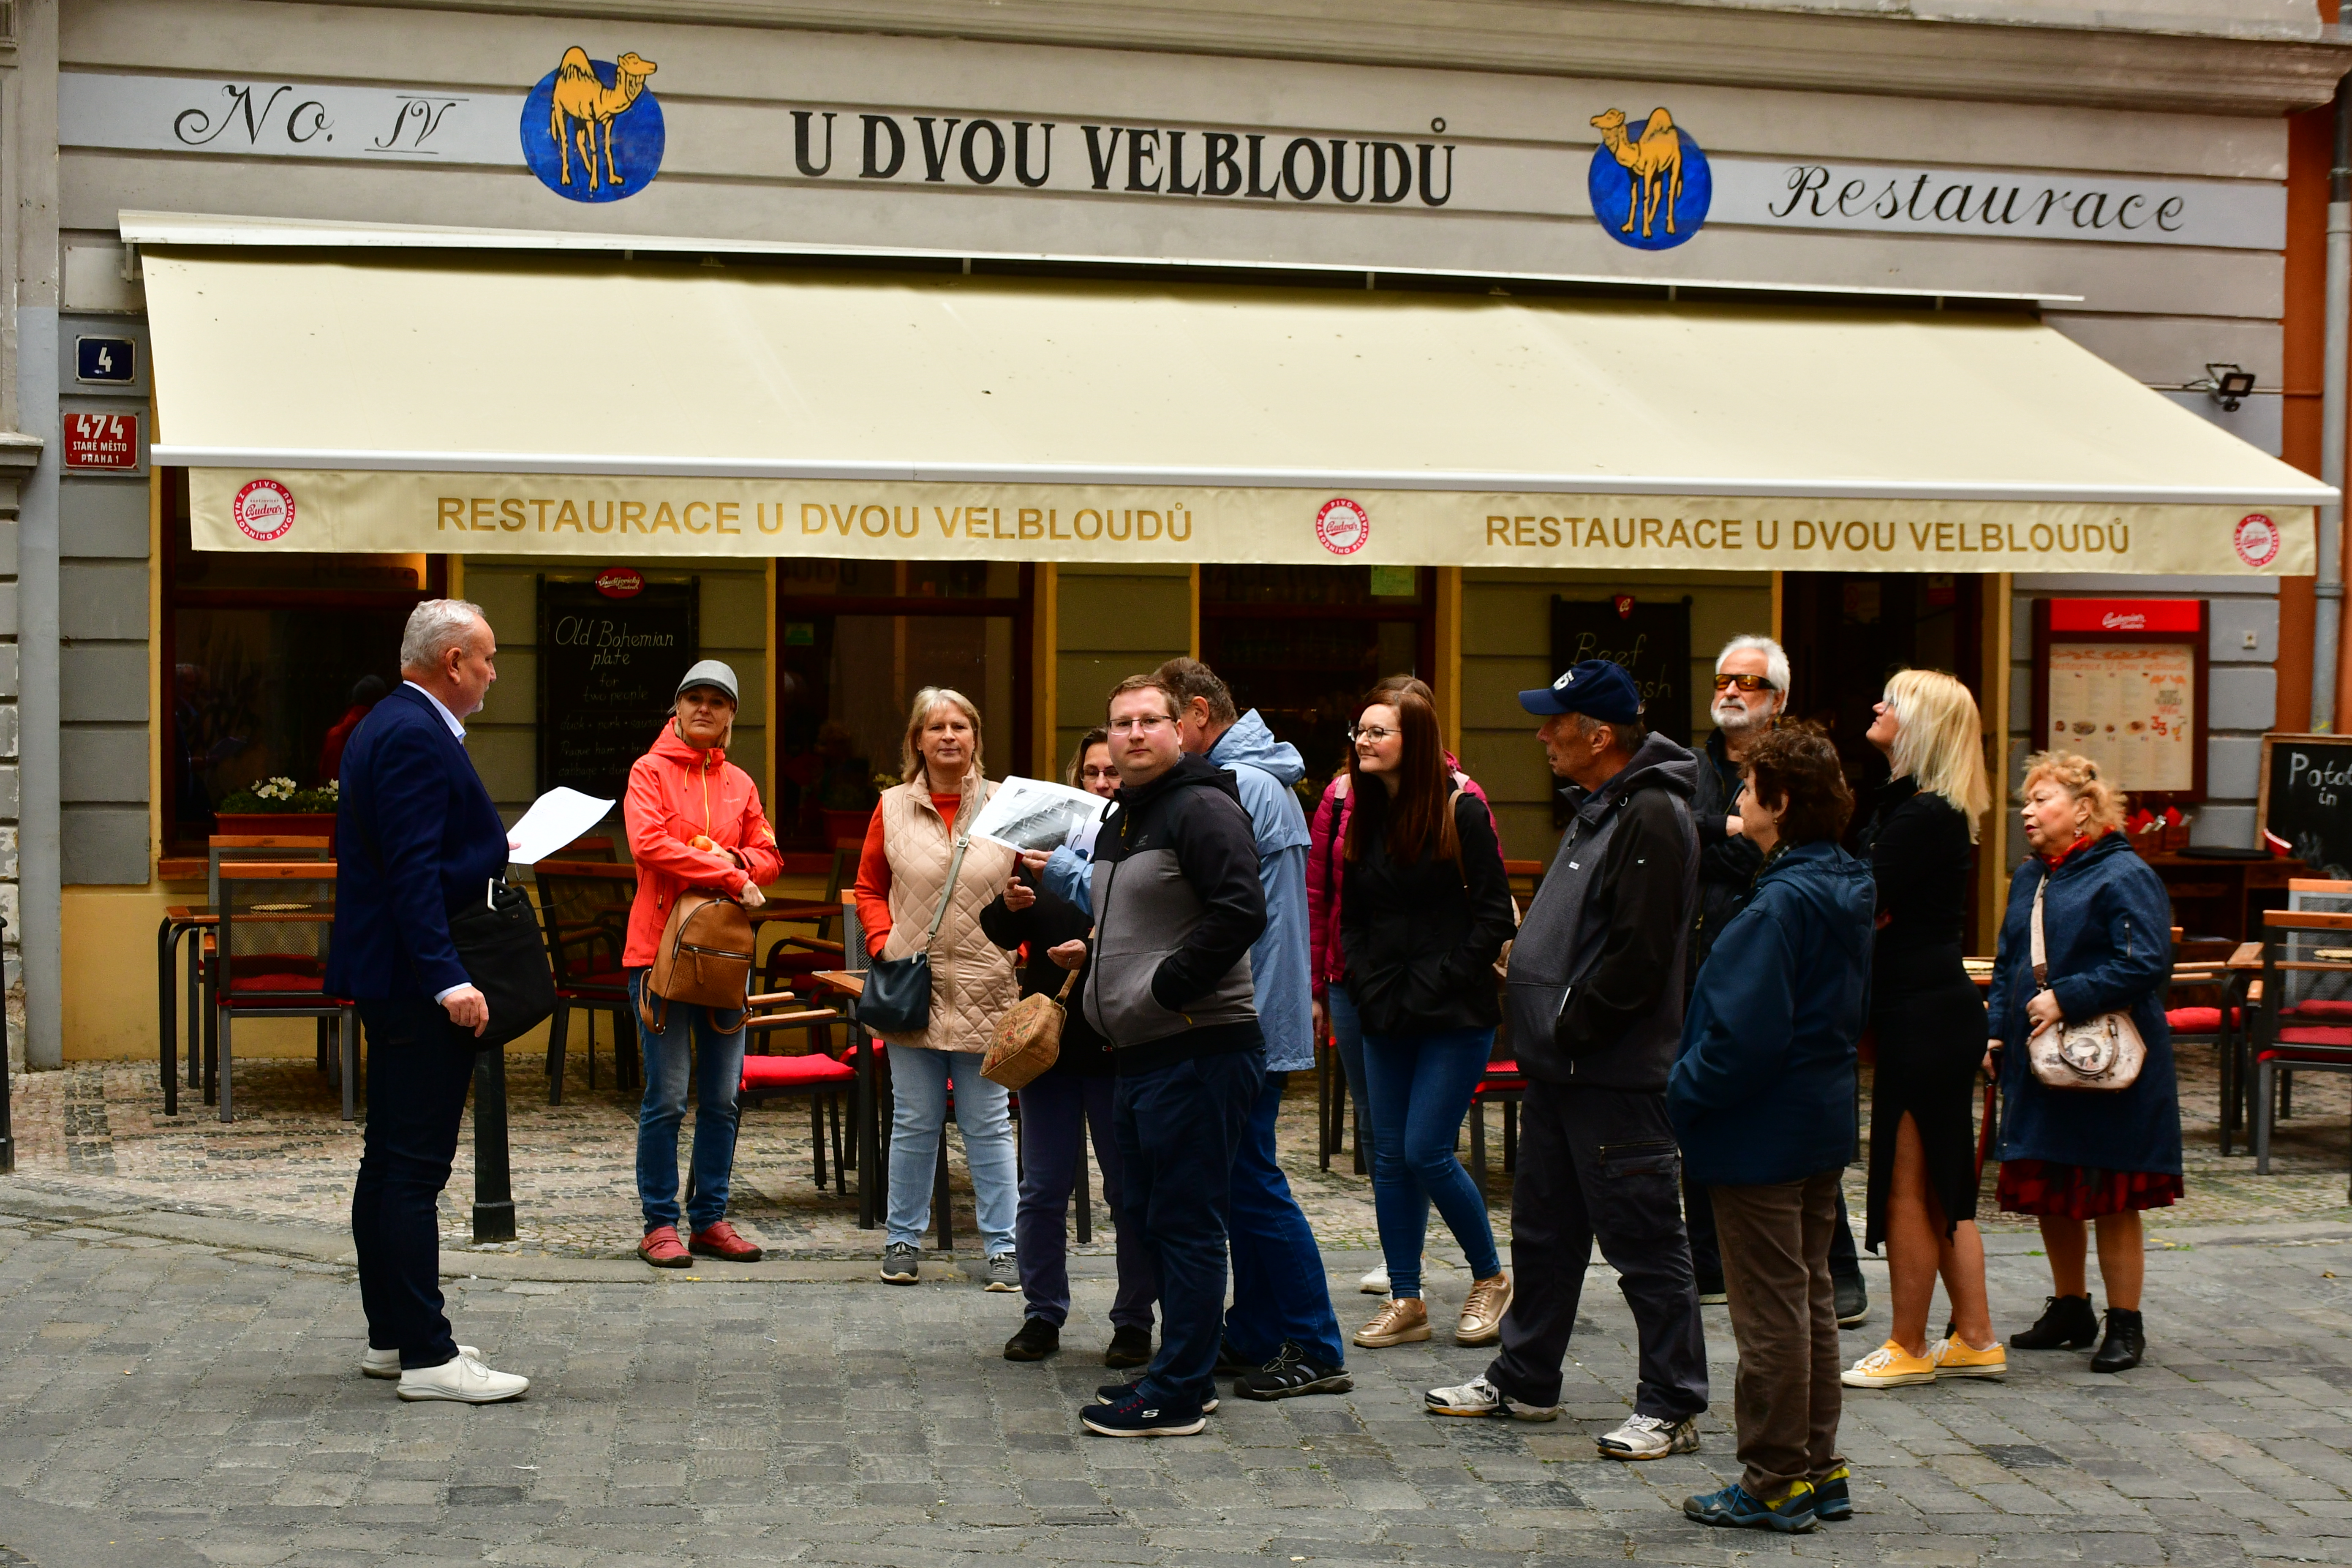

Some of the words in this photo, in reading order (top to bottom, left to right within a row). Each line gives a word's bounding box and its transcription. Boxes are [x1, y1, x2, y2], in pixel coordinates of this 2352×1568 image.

[174, 84, 335, 145] No.
[789, 111, 838, 177] U
[859, 114, 1056, 188] DVOU
[1080, 117, 1456, 207] VELBLOUDŮ
[1768, 166, 2185, 232] Restaurace
[98, 346, 112, 373] 4
[76, 414, 124, 440] 474
[73, 440, 97, 451] STARÉ
[101, 440, 127, 452] MĚSTO
[82, 455, 112, 464] PRAHA
[116, 455, 119, 464] 1
[252, 481, 277, 489] PIVO
[245, 504, 284, 517] Budvar
[276, 492, 294, 536] PIVOVARU
[437, 497, 741, 535] RESTAURACE
[757, 503, 784, 535] U
[800, 504, 920, 539] DVOU
[933, 502, 1192, 542] VELBLOUDŮ
[1486, 515, 1743, 550] RESTAURACE
[1756, 520, 1779, 551] U
[1793, 520, 1896, 552] DVOU
[1908, 517, 2129, 554] VELBLOUDŮ
[555, 615, 594, 645] Old
[596, 621, 673, 648] Bohemian
[590, 648, 631, 671] plate
[1570, 632, 1647, 667] Beef
[599, 672, 619, 687] for
[583, 686, 607, 702] two
[610, 685, 648, 707] people
[2318, 787, 2338, 806] in
